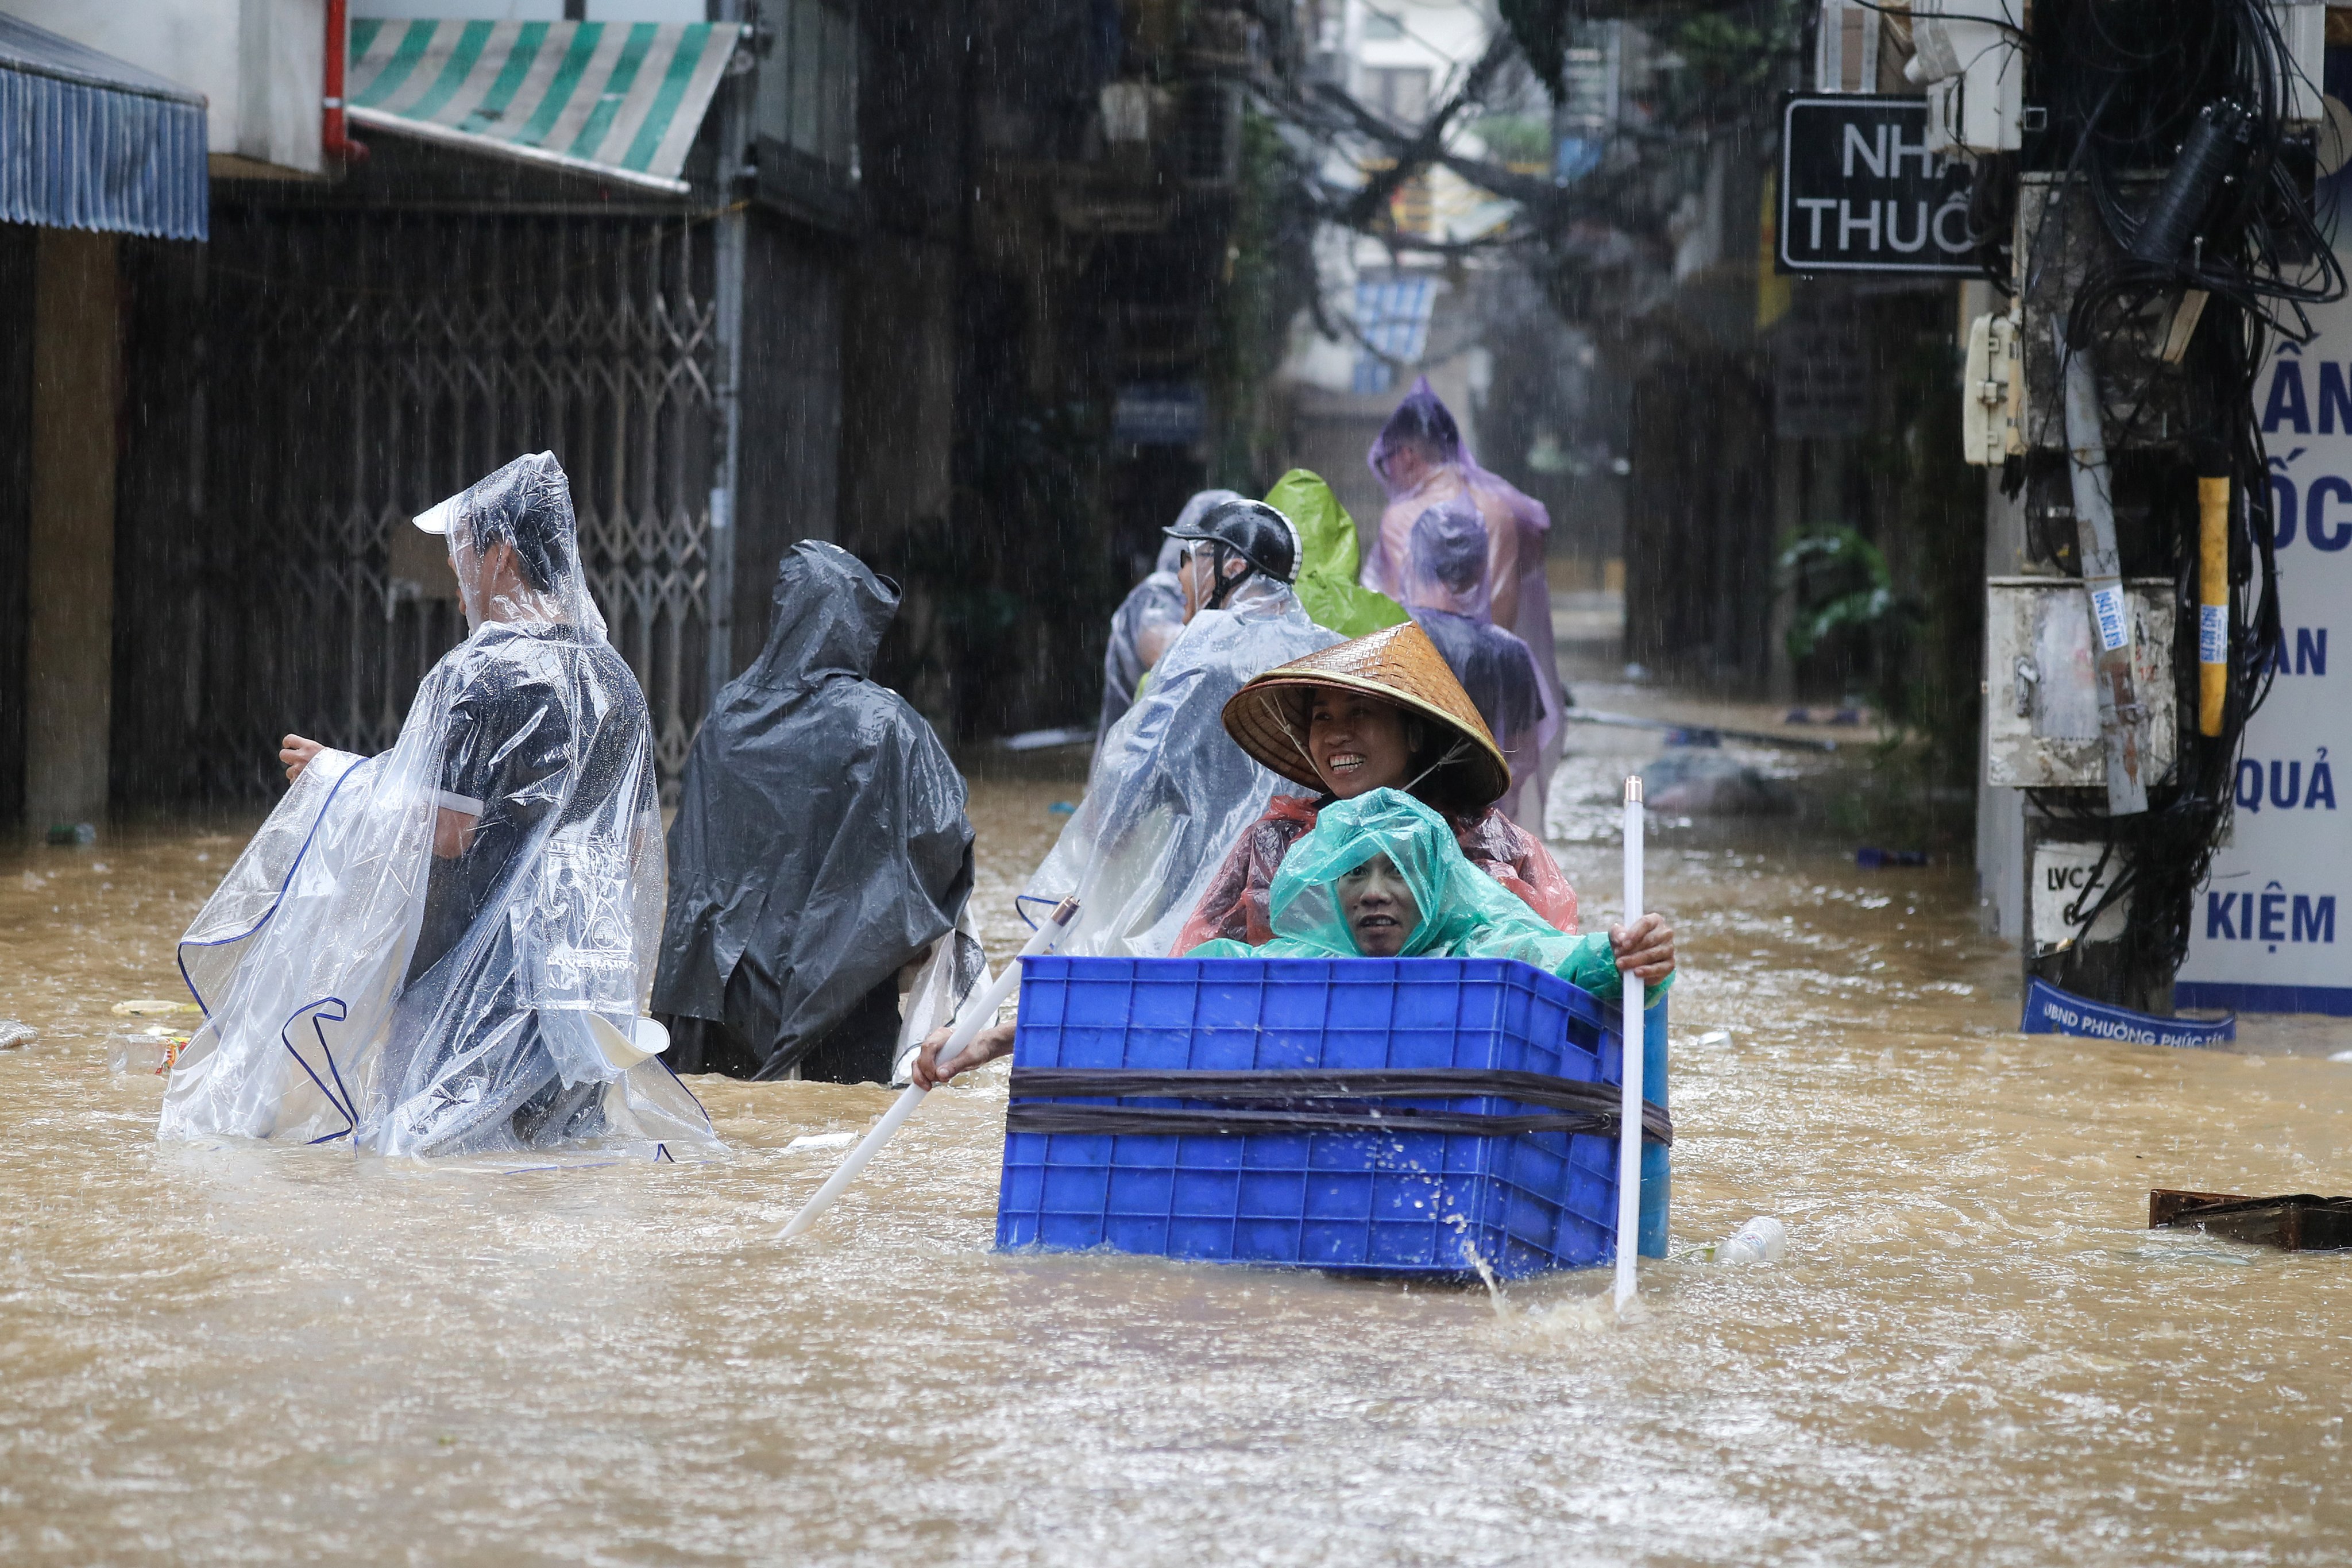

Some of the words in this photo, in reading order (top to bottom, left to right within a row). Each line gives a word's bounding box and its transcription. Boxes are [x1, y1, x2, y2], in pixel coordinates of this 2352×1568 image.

[1796, 185, 2011, 254] THUỐ
[2235, 747, 2336, 814] QUẢ
[2207, 881, 2336, 953] KIỆM
[2044, 1002, 2079, 1027] UBND
